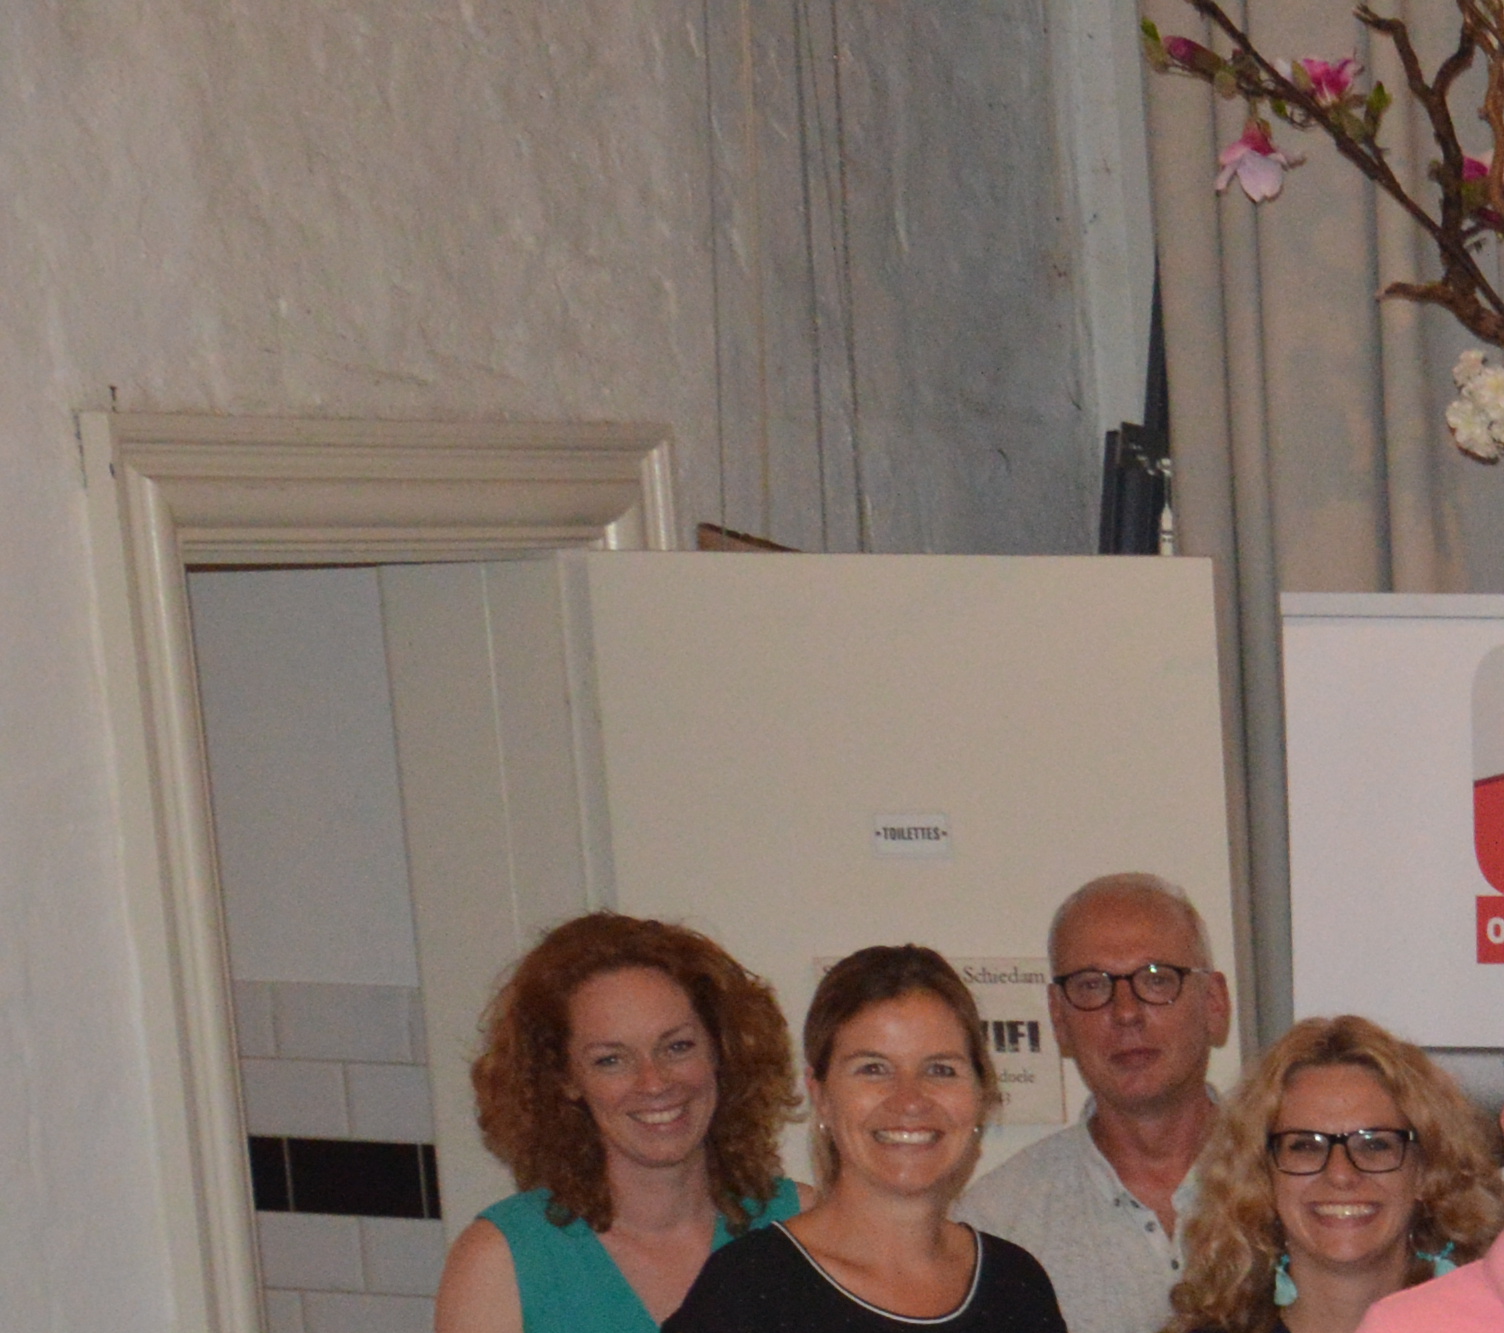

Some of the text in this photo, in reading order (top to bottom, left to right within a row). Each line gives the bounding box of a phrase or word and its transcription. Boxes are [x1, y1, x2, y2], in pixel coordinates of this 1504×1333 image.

[882, 826, 941, 841] TOILETTES
[963, 965, 1046, 985] Schiedam
[980, 1020, 1041, 1053] IFI
